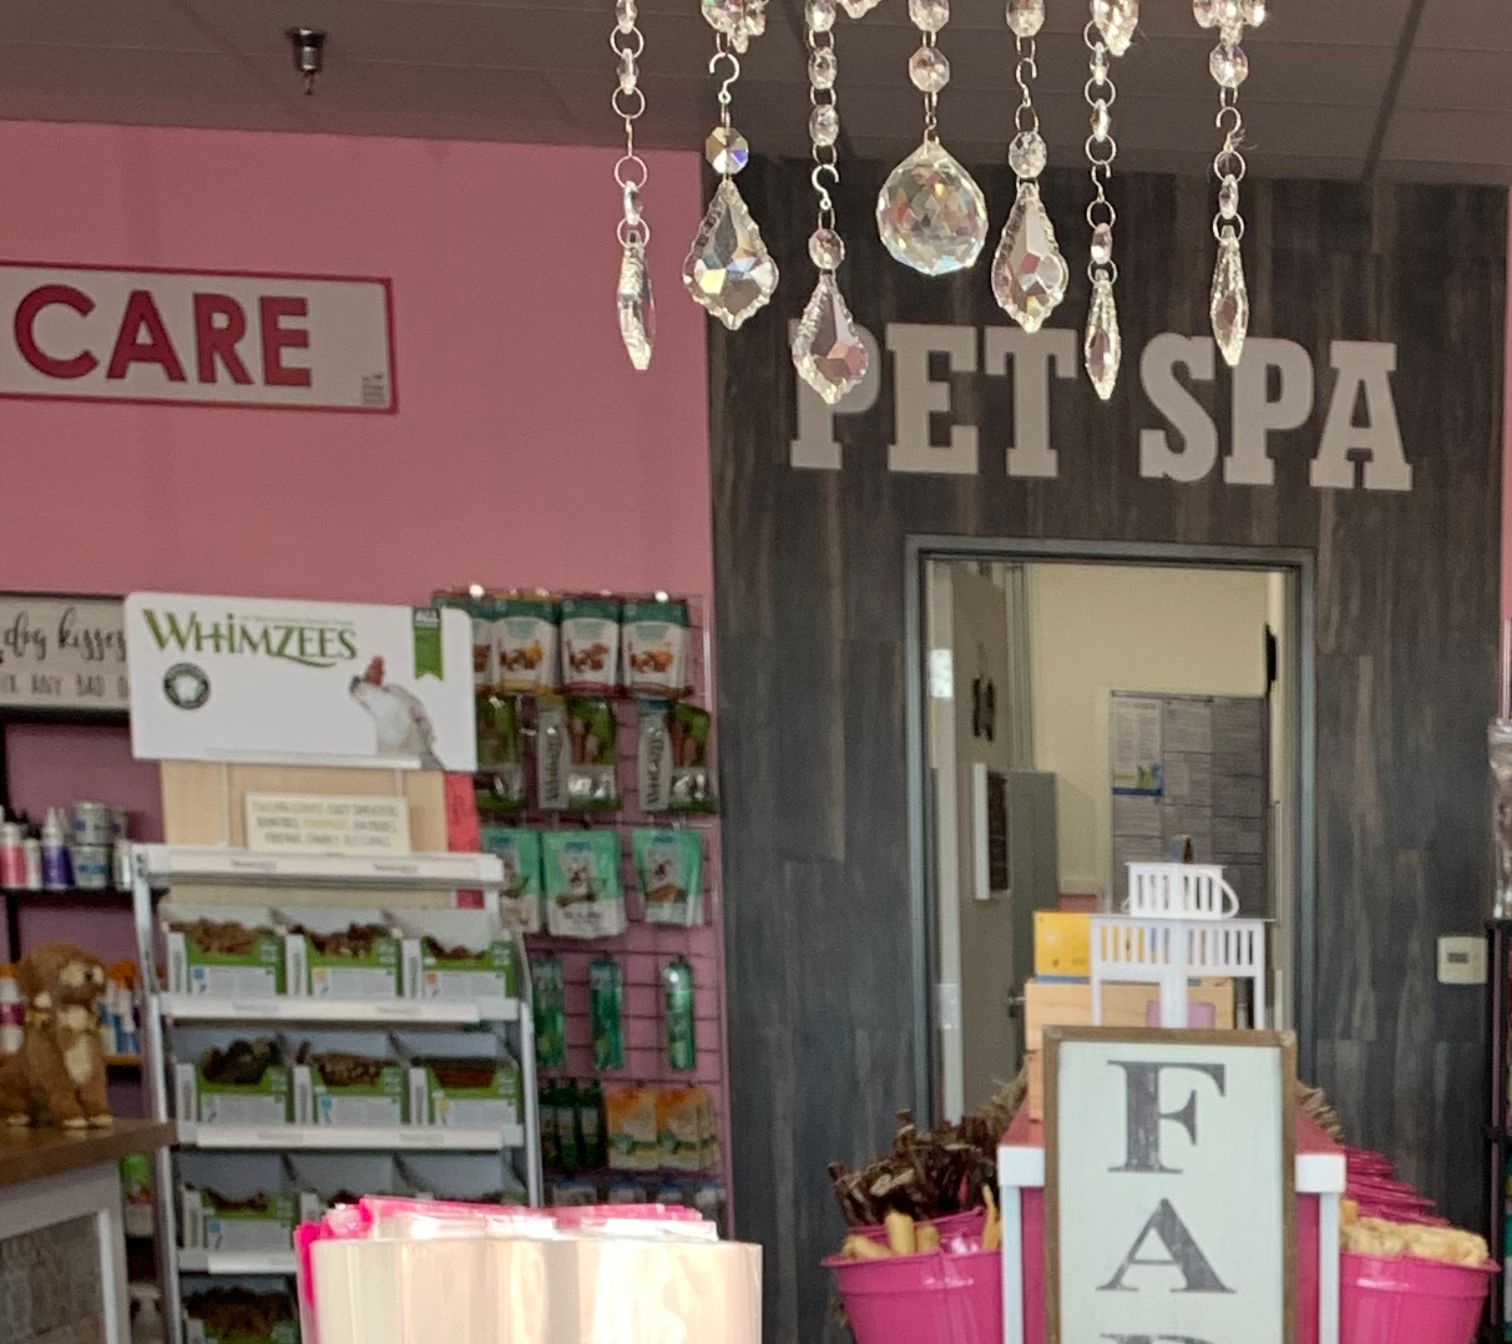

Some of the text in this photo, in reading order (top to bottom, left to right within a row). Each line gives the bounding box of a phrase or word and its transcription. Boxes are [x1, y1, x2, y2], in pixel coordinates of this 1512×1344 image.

[13, 284, 312, 388] CARE
[789, 318, 1413, 491] PET SPA
[142, 607, 358, 668] WHIMZEES
